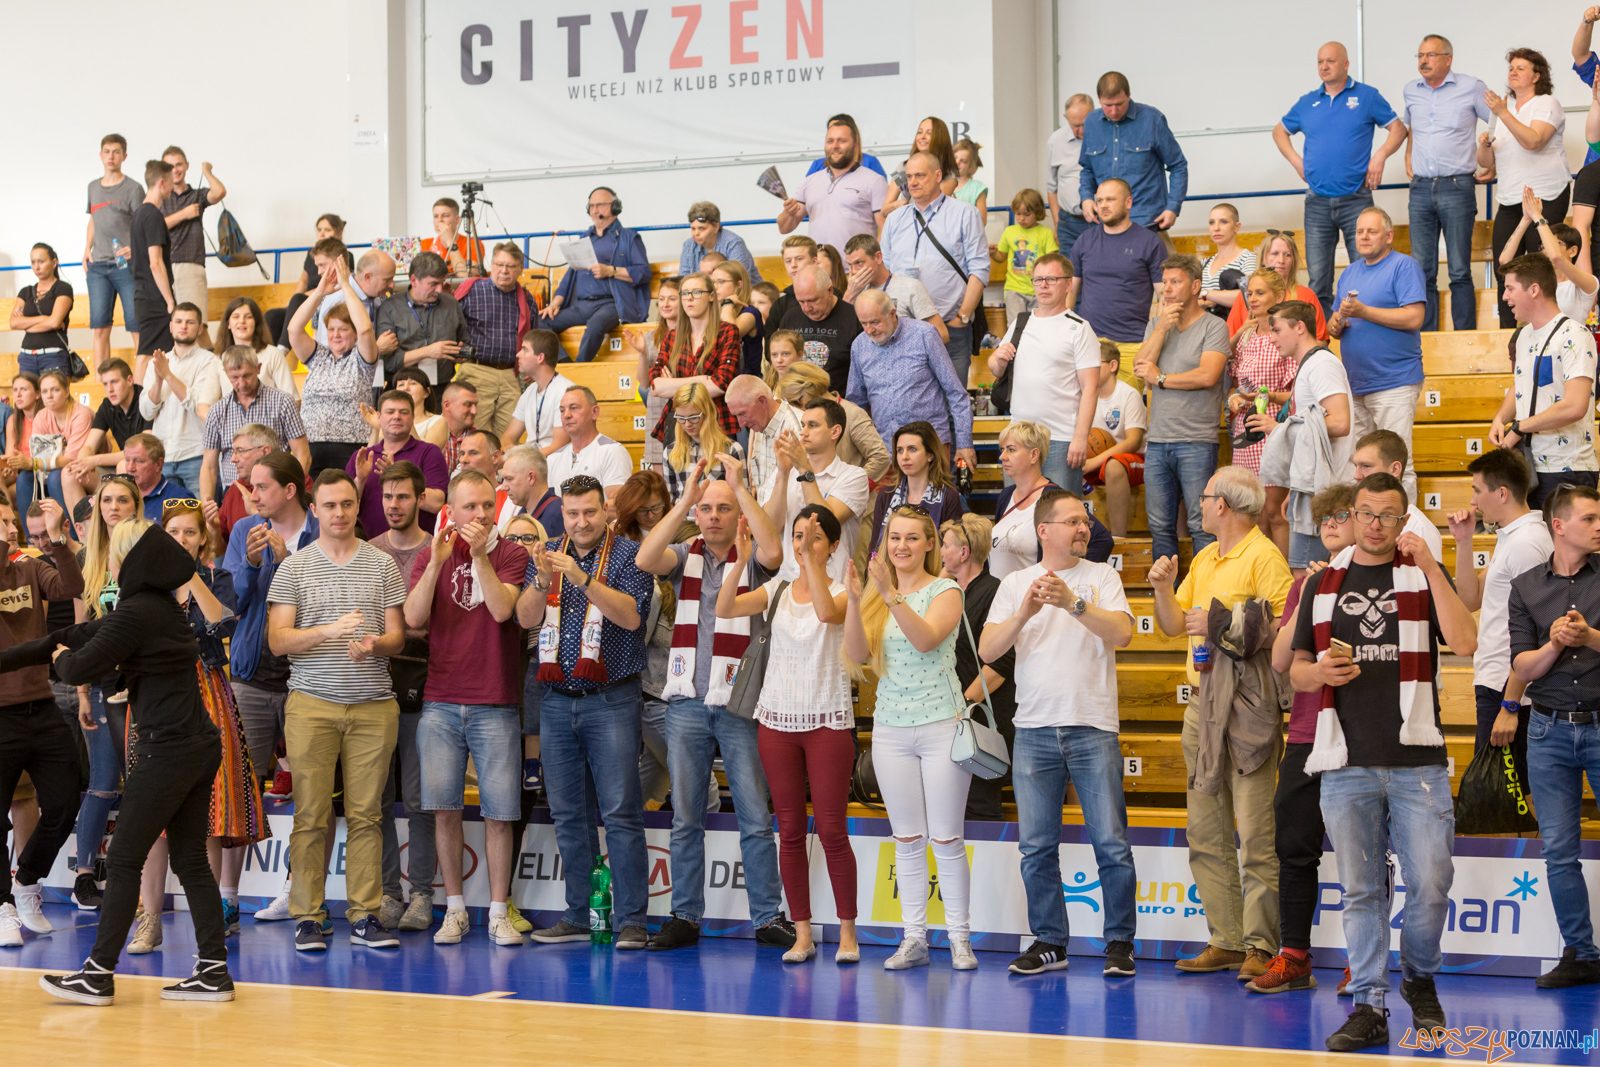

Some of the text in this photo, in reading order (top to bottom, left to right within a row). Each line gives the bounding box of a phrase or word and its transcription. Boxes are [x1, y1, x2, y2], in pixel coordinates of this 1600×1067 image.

[460, 0, 824, 86] CITYZEN
[568, 66, 825, 101] WIĘCEJ NIŻ KLUB SPORTOWY
[611, 339, 621, 350] 17
[620, 378, 630, 388] 14
[1430, 394, 1437, 405] 5
[635, 418, 645, 428] 13
[1470, 441, 1478, 453] 4
[1429, 496, 1437, 507] 4
[1112, 557, 1118, 568] 7
[1478, 554, 1486, 566] 3
[1142, 618, 1150, 631] 6
[1182, 688, 1189, 701] 5
[1129, 760, 1137, 773] 5
